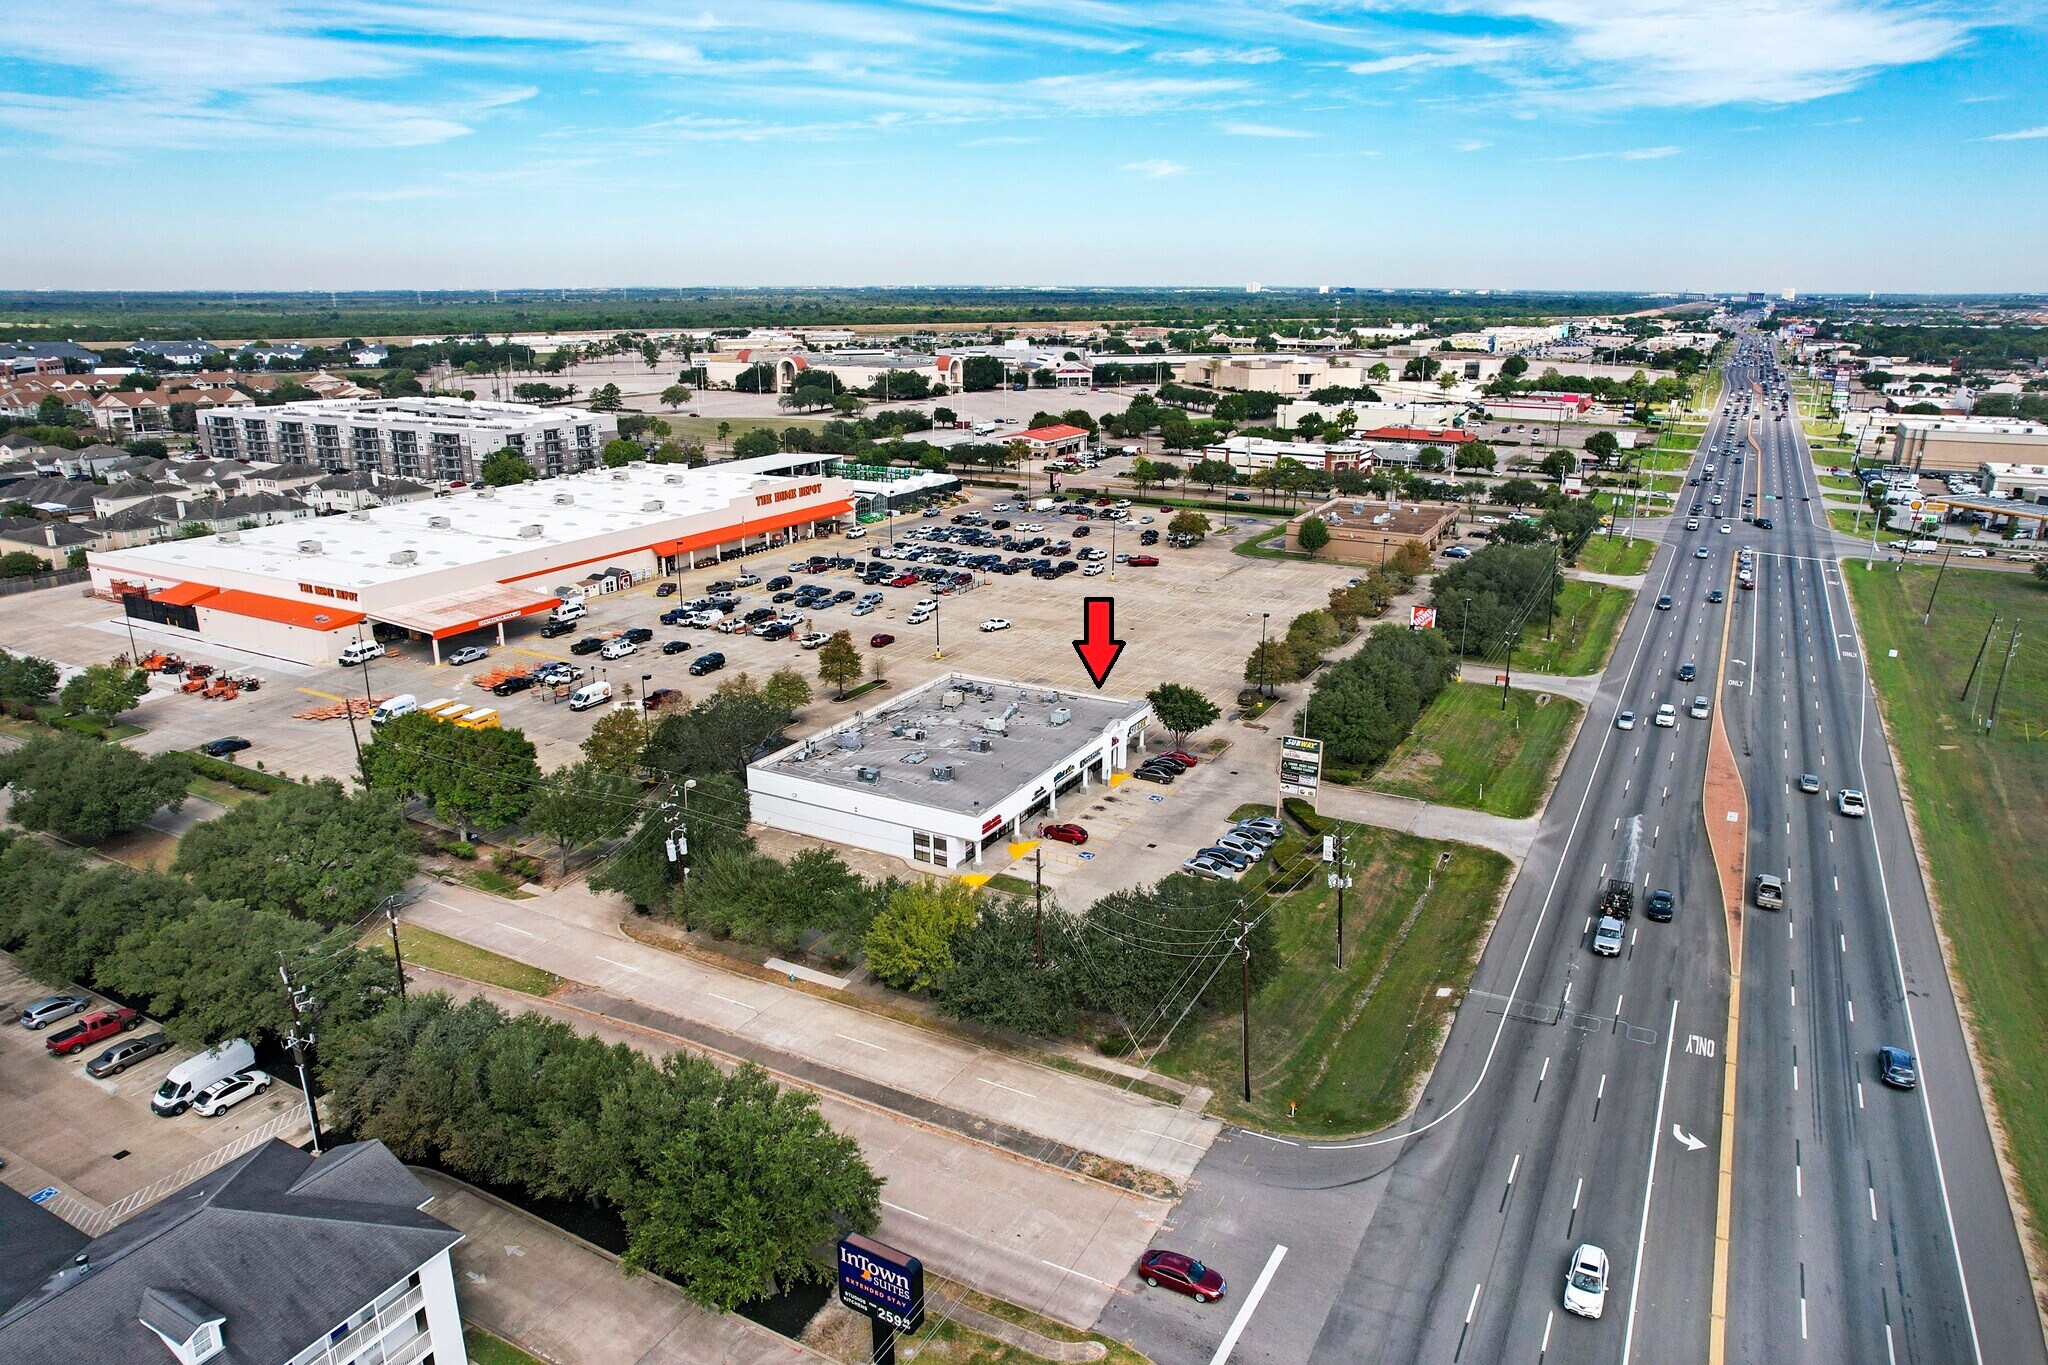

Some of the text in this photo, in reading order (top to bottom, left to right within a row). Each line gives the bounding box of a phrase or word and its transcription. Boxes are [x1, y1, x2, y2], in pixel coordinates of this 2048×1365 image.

[755, 483, 822, 506] THE HOME DEPOT
[298, 583, 358, 602] THE HOME DEPOT
[1727, 679, 1745, 688] ONLY
[1285, 739, 1318, 749] SUBWAY
[1685, 1034, 1716, 1058] ONLY
[840, 1246, 910, 1291] InTown
[844, 1291, 867, 1305] STUDIOS
[845, 1276, 906, 1308] EXTENDED STAY
[873, 1276, 911, 1300] SUITES
[843, 1296, 868, 1311] KITCHENS
